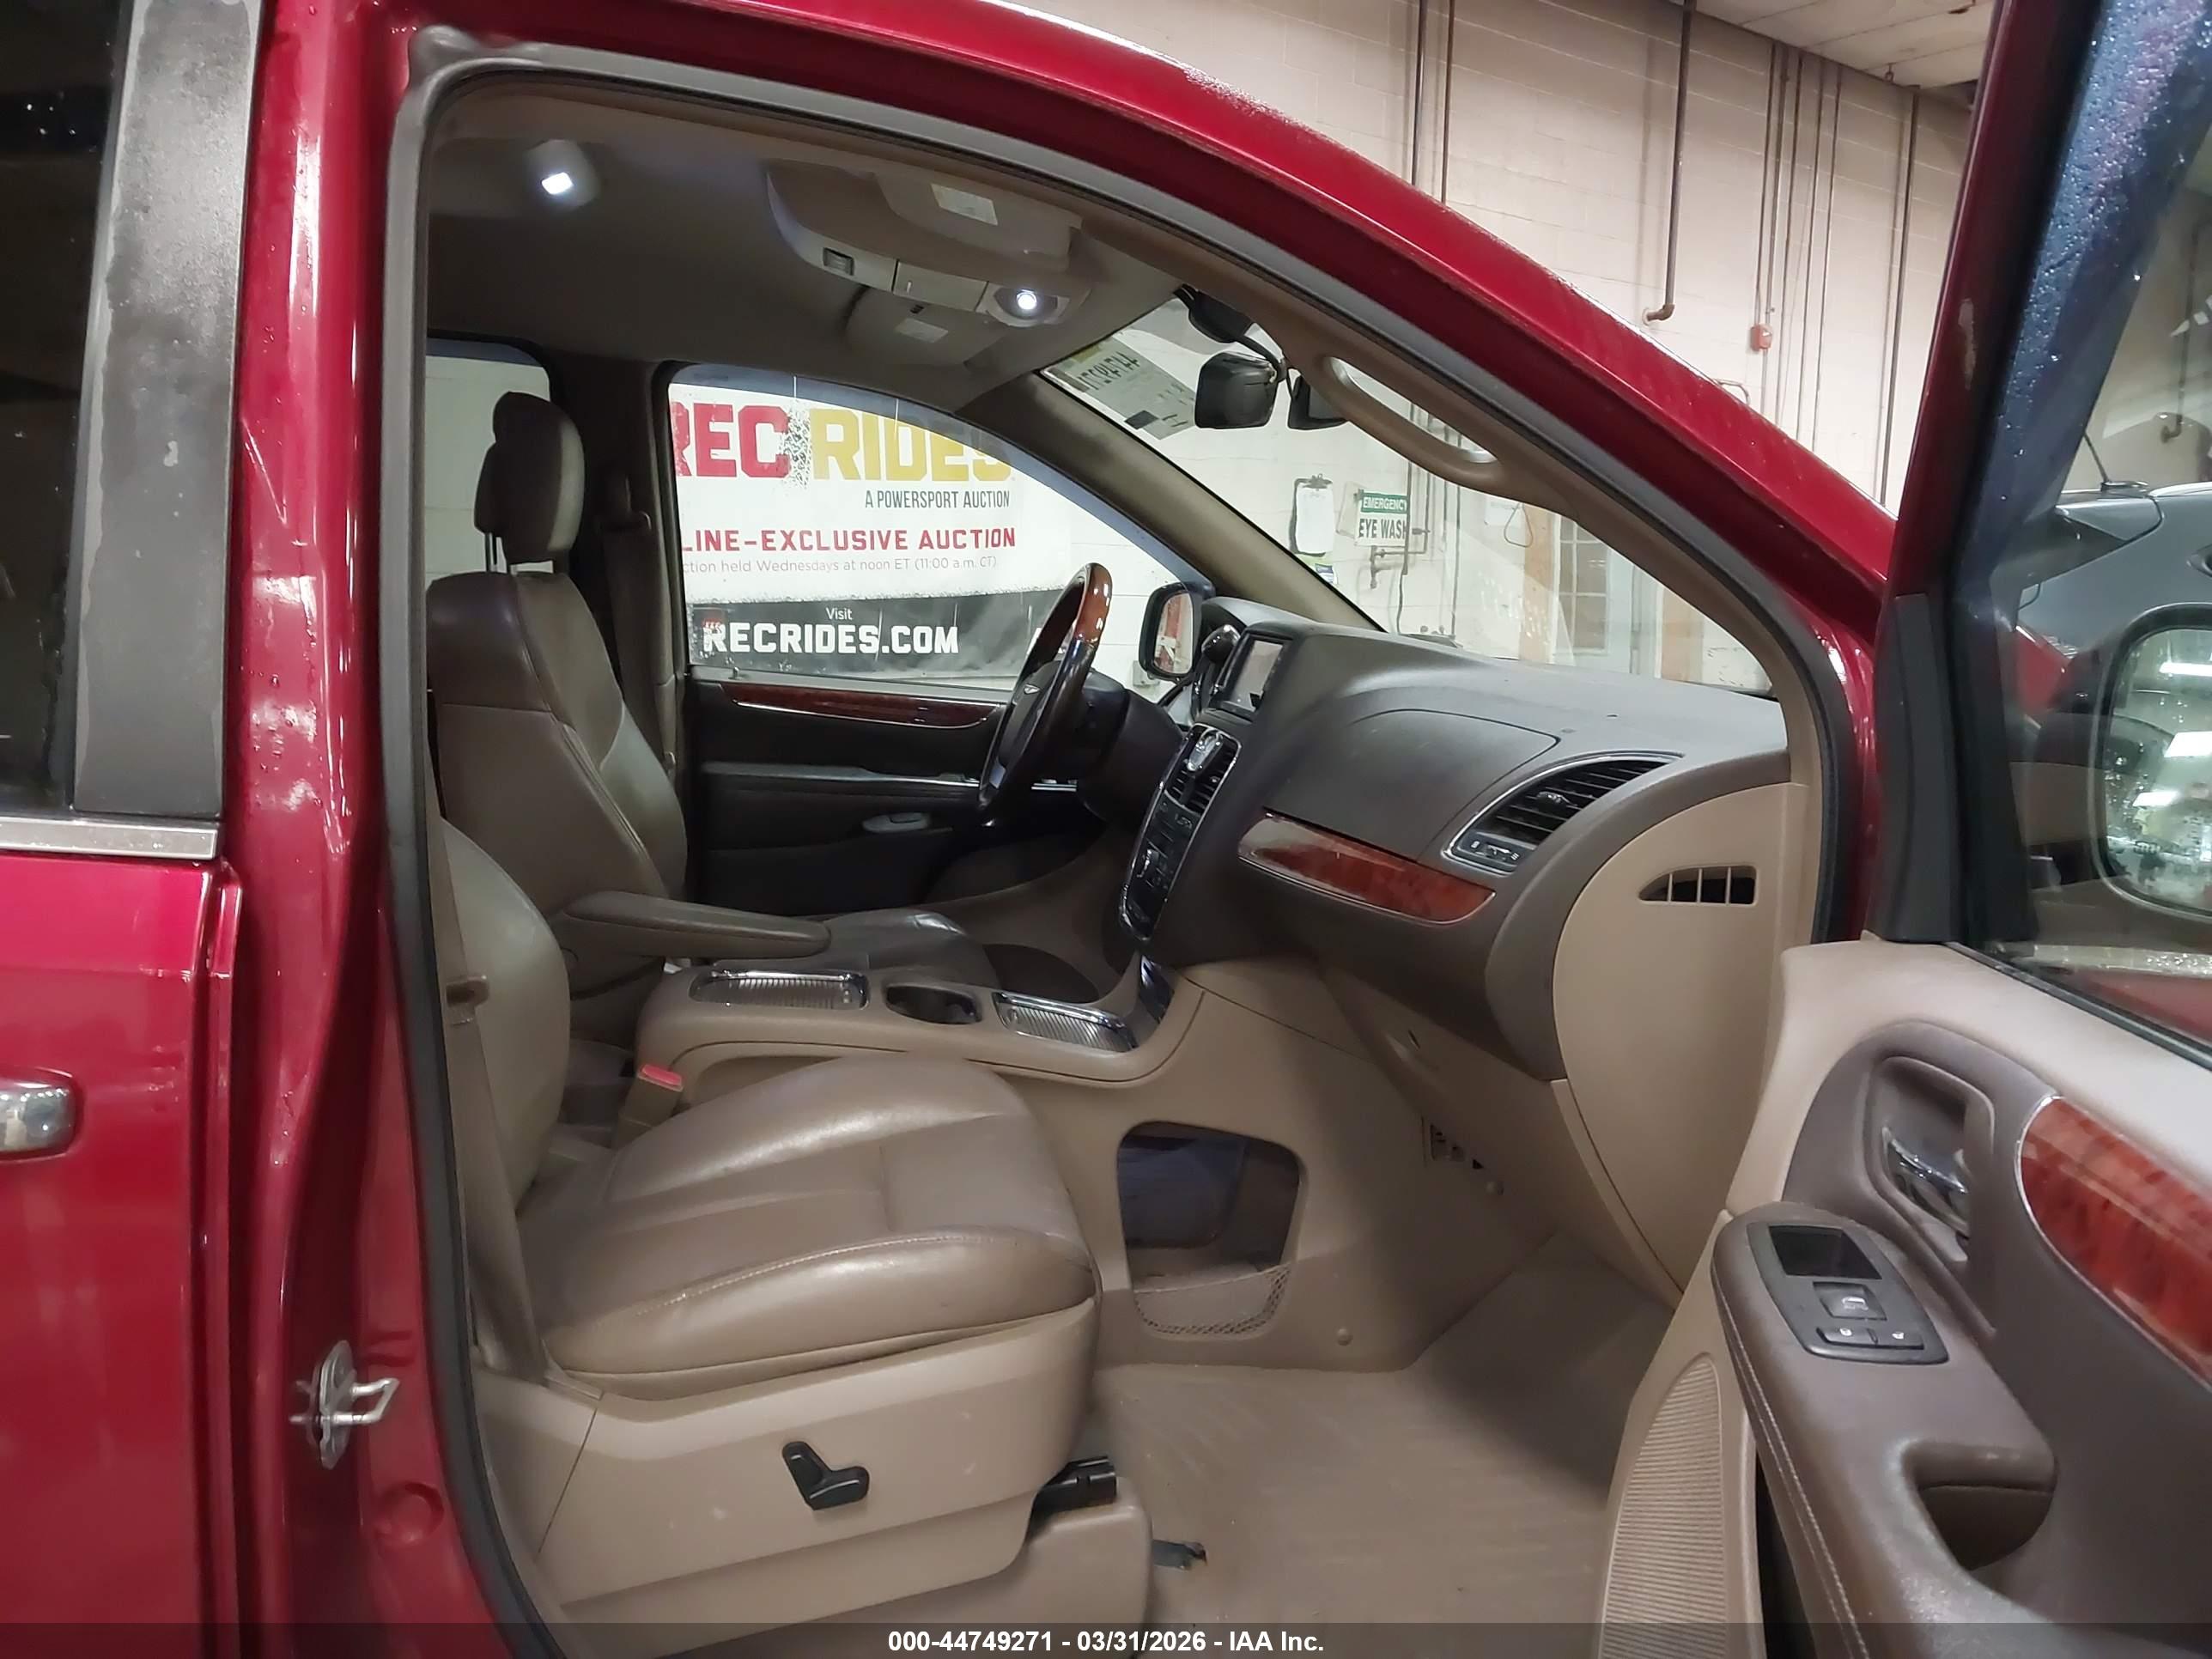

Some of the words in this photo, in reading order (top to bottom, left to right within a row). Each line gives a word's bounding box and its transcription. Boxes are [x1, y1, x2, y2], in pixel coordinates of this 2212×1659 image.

[865, 490, 873, 508] A
[877, 490, 959, 509] POWERSPORT
[963, 489, 1010, 508] AUCTION
[1358, 518, 1377, 538] EYE
[918, 527, 1016, 550] AUCTION
[720, 560, 751, 573] held
[756, 559, 839, 574] Wednesdays
[843, 559, 856, 571] at
[860, 560, 890, 572] noon
[894, 558, 911, 570] ET
[979, 556, 997, 568] CT)
[825, 607, 853, 620] Visit
[702, 622, 959, 653] RECRIDES.COM
